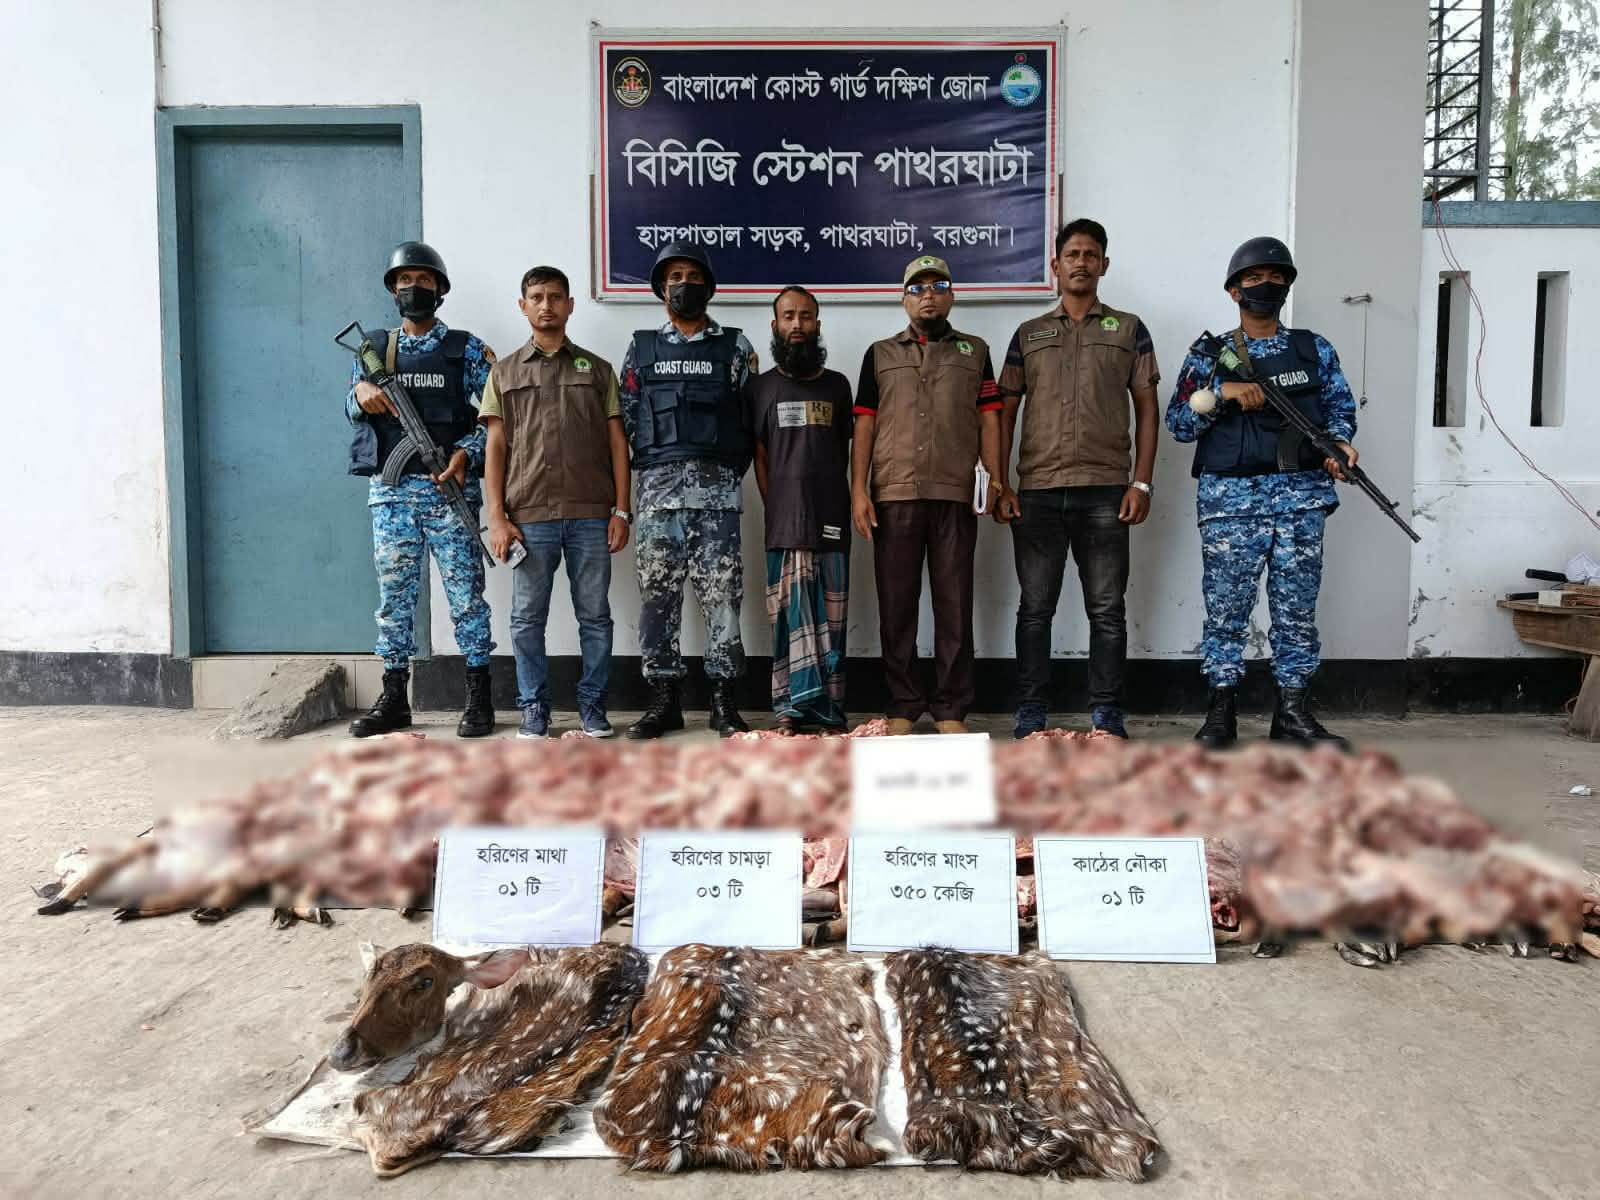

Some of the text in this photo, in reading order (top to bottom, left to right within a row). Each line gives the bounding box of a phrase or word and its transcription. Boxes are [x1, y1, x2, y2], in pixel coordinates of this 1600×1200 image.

[661, 73, 758, 102] বাংলাদেশ
[765, 69, 823, 101] কোস্ট
[830, 62, 870, 101] গার্ড
[873, 67, 935, 101] দক্ষিণ
[941, 73, 990, 101] জোন
[621, 138, 1034, 188] বিসিজি স্টেশন পাথরঘাটা
[636, 223, 744, 249] হাসপাতাল
[749, 226, 811, 253] সড়ক,
[820, 219, 924, 252] পাথরঘাটা,
[931, 223, 1002, 248] বরগুনা
[654, 360, 713, 374] COAST GUARD
[413, 373, 445, 388] GUARD
[1279, 370, 1309, 387] GUARD
[476, 843, 568, 865] হরিণের মাথা
[670, 845, 772, 869] হরিণের চামড়া
[884, 846, 978, 871] হরিণের মাংস
[1072, 851, 1168, 873] কাঠের নৌকা
[498, 876, 542, 897] ০১ টি
[696, 878, 744, 899] ০৩ টি
[890, 881, 975, 903] ৩৫০ কেজি
[1102, 885, 1145, 906] ০১ টি
